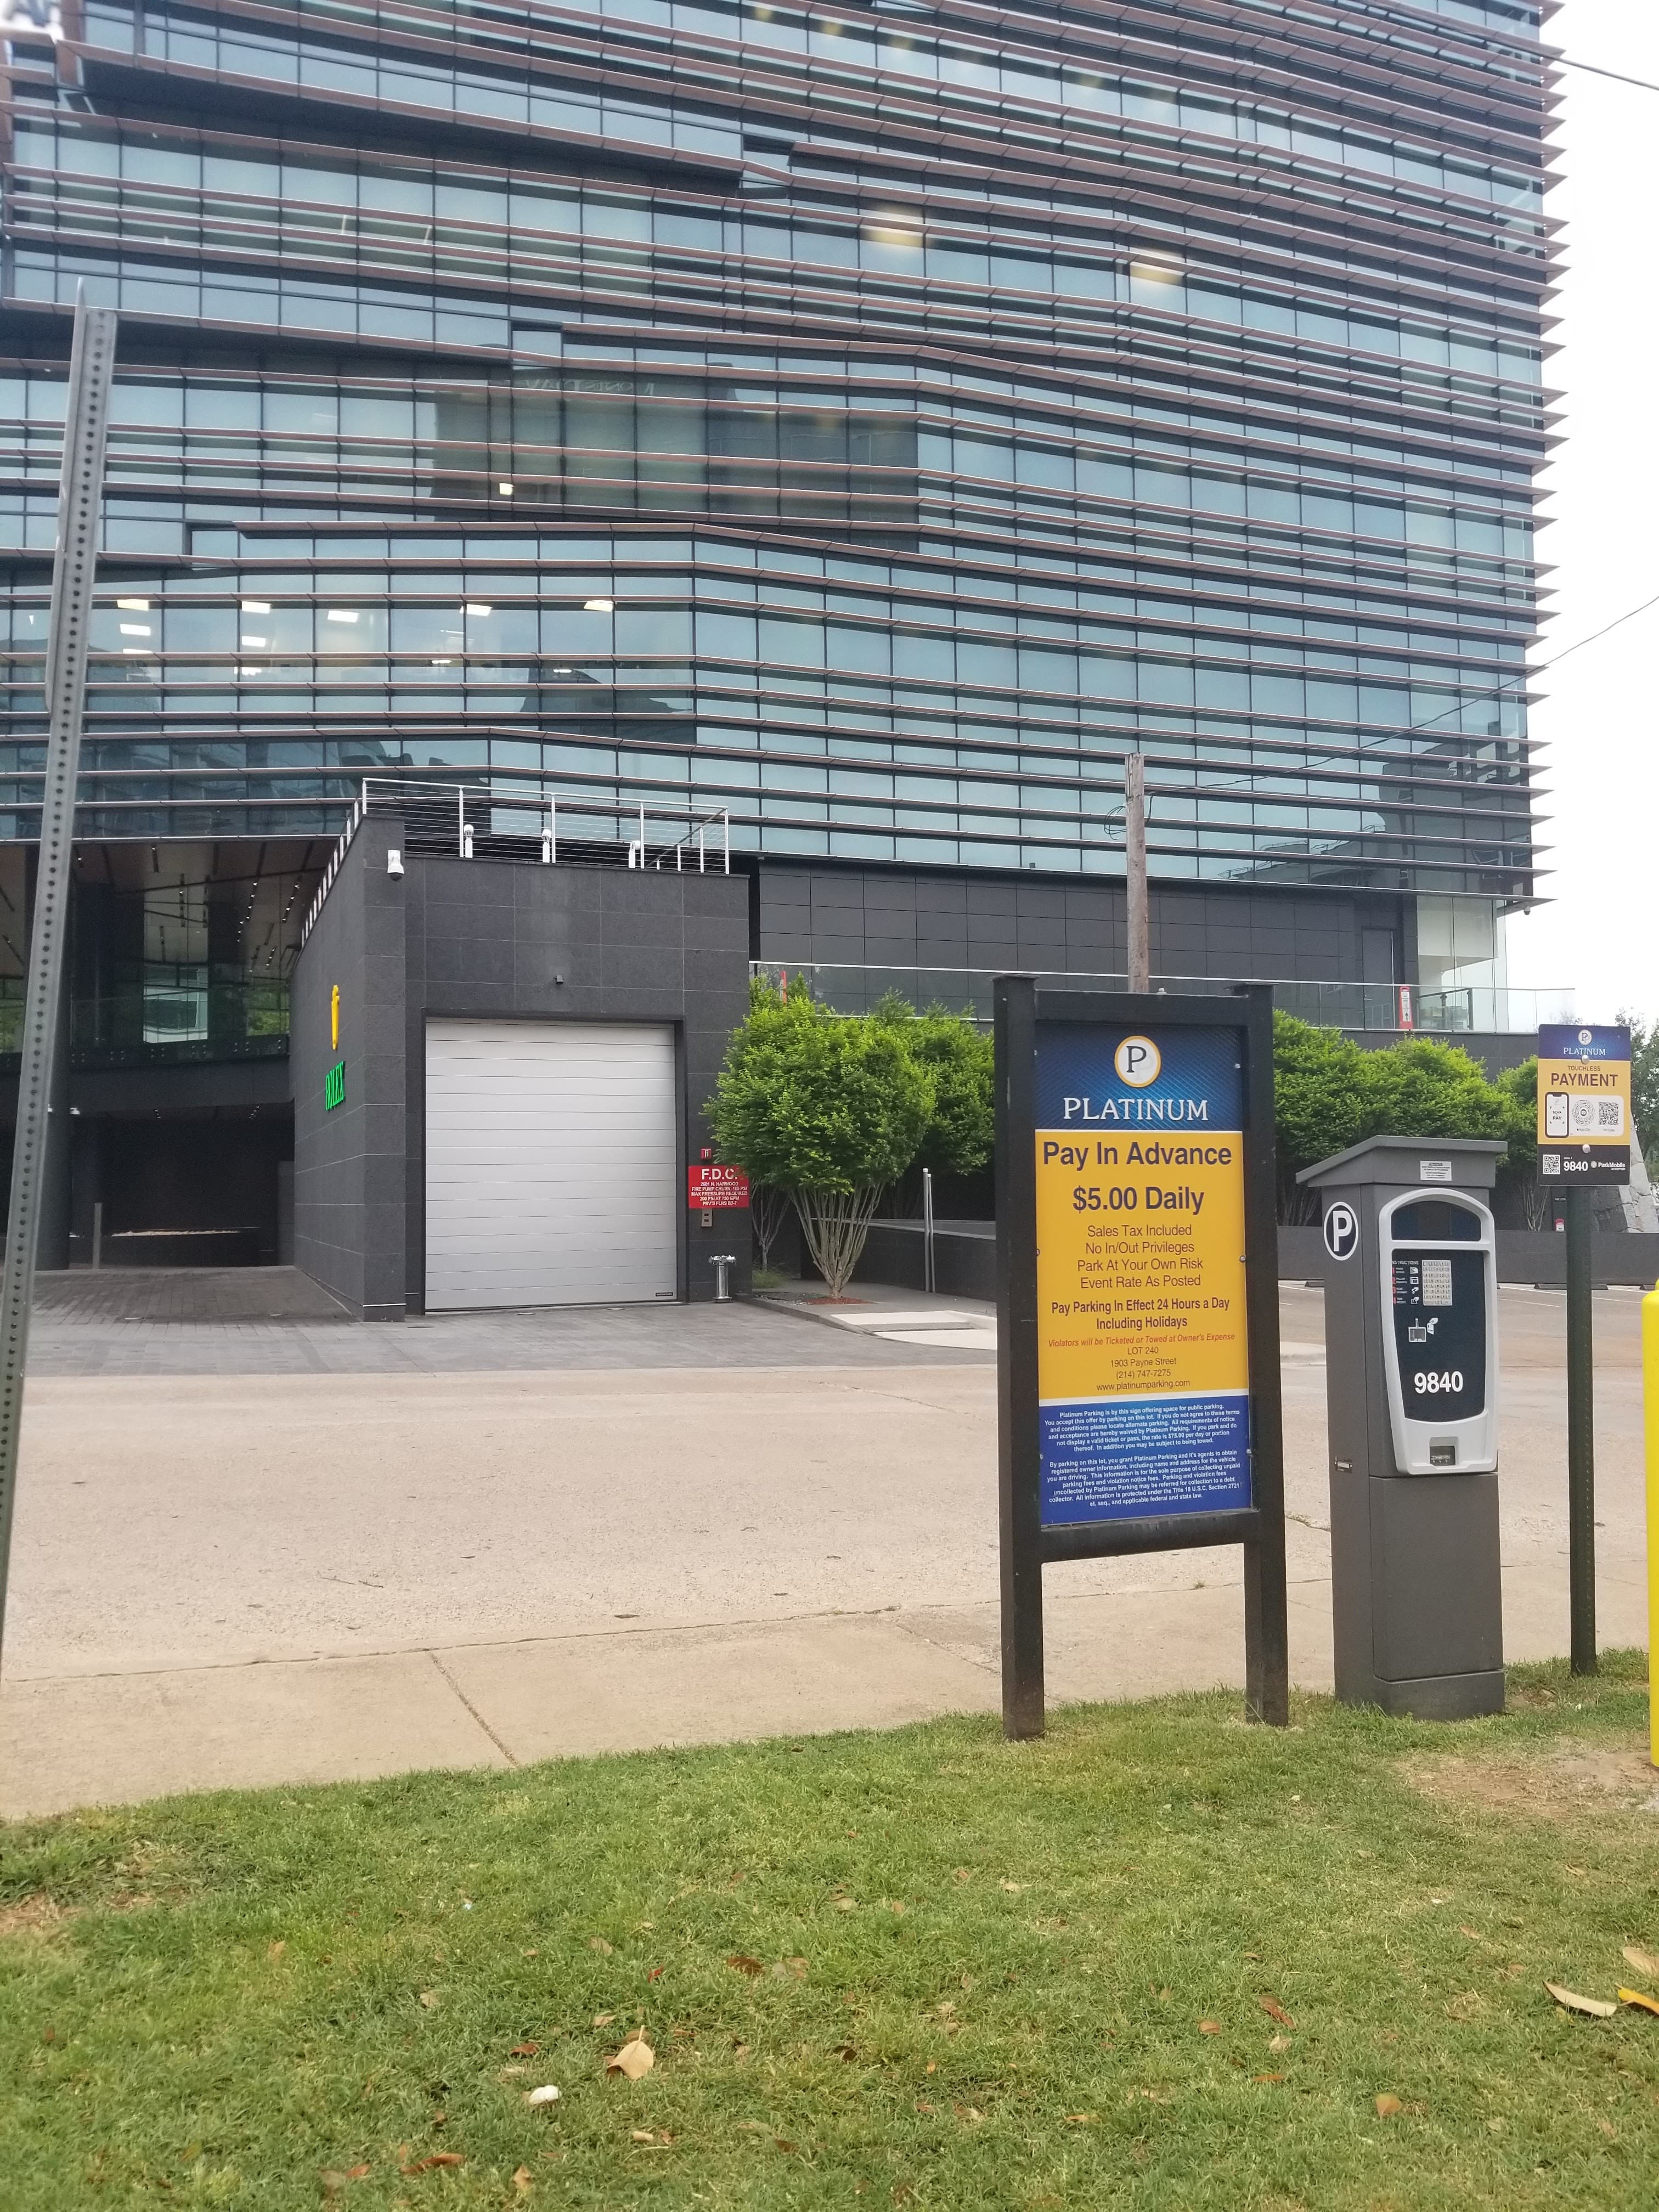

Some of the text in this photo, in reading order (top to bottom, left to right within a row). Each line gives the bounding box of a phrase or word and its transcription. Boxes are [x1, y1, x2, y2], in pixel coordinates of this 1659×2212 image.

[1564, 1047, 1605, 1056] PLATINUM
[1126, 1046, 1147, 1073] P
[325, 1060, 345, 1110] ROLEX
[1551, 1073, 1618, 1086] PAYMENT
[1063, 1097, 1209, 1121] PLATINUM
[1044, 1142, 1231, 1171] Pay In Advance
[1564, 1161, 1588, 1171] 9840
[702, 1169, 737, 1180] F.D.C.
[1073, 1186, 1204, 1215] $5.00 Daily
[1088, 1224, 1192, 1237] Sales Tax Included
[1333, 1210, 1352, 1252] P
[1086, 1242, 1194, 1255] No In/Out Privileges
[1078, 1258, 1203, 1271] Park At Your Own Risk
[1081, 1274, 1200, 1288] Event Rate As Posted
[1052, 1302, 1070, 1316] Pay
[1074, 1301, 1111, 1314] Parking
[1115, 1300, 1122, 1311] In
[1127, 1300, 1154, 1311] Effect
[1158, 1299, 1168, 1310] 24
[1172, 1299, 1200, 1309] Hours
[1212, 1297, 1229, 1311] Day
[1097, 1316, 1187, 1331] Including Holidays
[1106, 1336, 1134, 1345] Ticketed
[1131, 1359, 1153, 1368] Payne
[1116, 1369, 1171, 1380] (214) 747-7275
[1097, 1380, 1190, 1391] www.platinumparking.com
[1414, 1371, 1463, 1393] 9840
[1084, 1409, 1104, 1418] Parking
[1142, 1406, 1162, 1414] offering
[1051, 1467, 1077, 1475] registered
[1129, 1462, 1153, 1470] including
[1058, 1460, 1078, 1468] parking
[1198, 1463, 1222, 1472] collecting
[1062, 1480, 1082, 1488] parking
[1163, 1473, 1182, 1481] Parking
